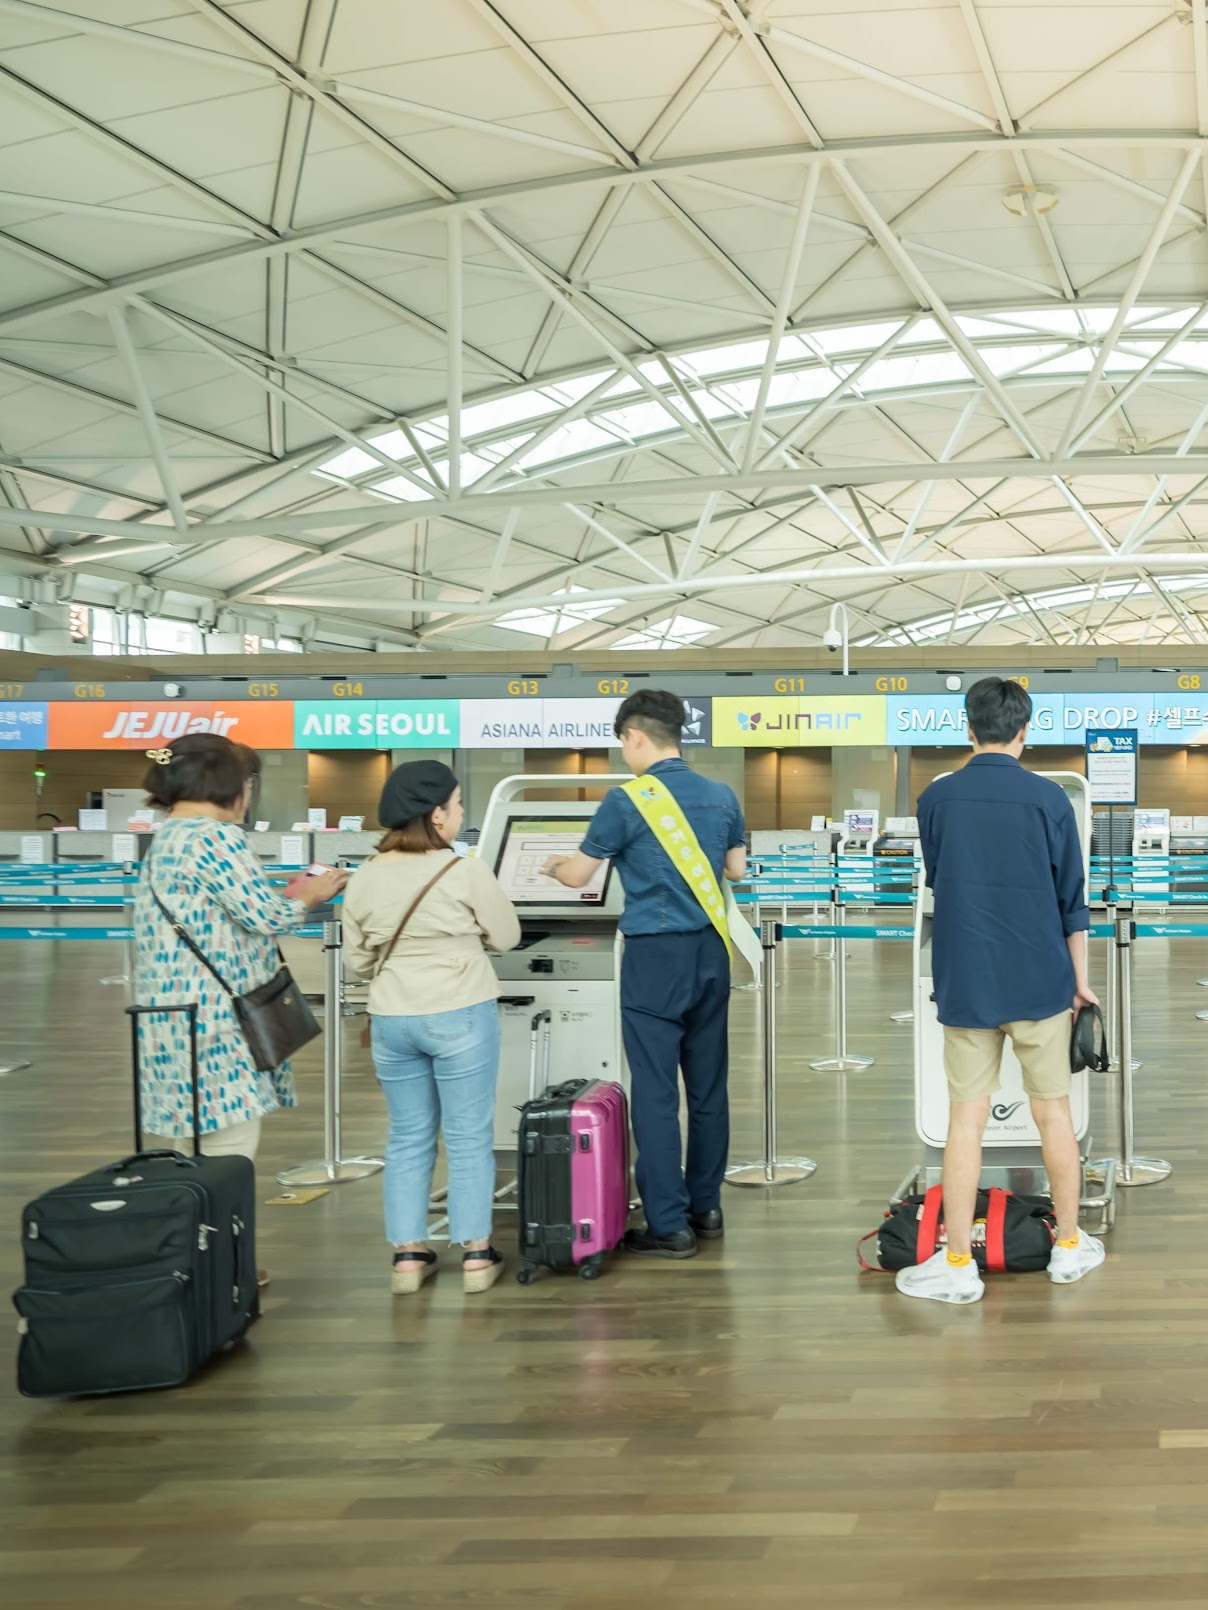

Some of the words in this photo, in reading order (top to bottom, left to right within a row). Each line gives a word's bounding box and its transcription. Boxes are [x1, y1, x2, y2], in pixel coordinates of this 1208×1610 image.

[507, 681, 539, 695] G13
[598, 679, 629, 694] G12
[774, 678, 805, 692] G11
[875, 677, 908, 692] G10
[1177, 674, 1201, 689] G8
[74, 684, 105, 698] G16
[248, 683, 279, 697] G15
[332, 682, 363, 696] G14
[102, 710, 240, 738] JEJUair
[302, 714, 352, 735] AIR
[357, 713, 451, 735] SEOUL
[1064, 706, 1138, 730] DROP
[481, 723, 542, 738] ASIANA
[548, 722, 617, 738] AIRLINE
[1114, 737, 1133, 745] TAX
[876, 929, 898, 937] SMART
